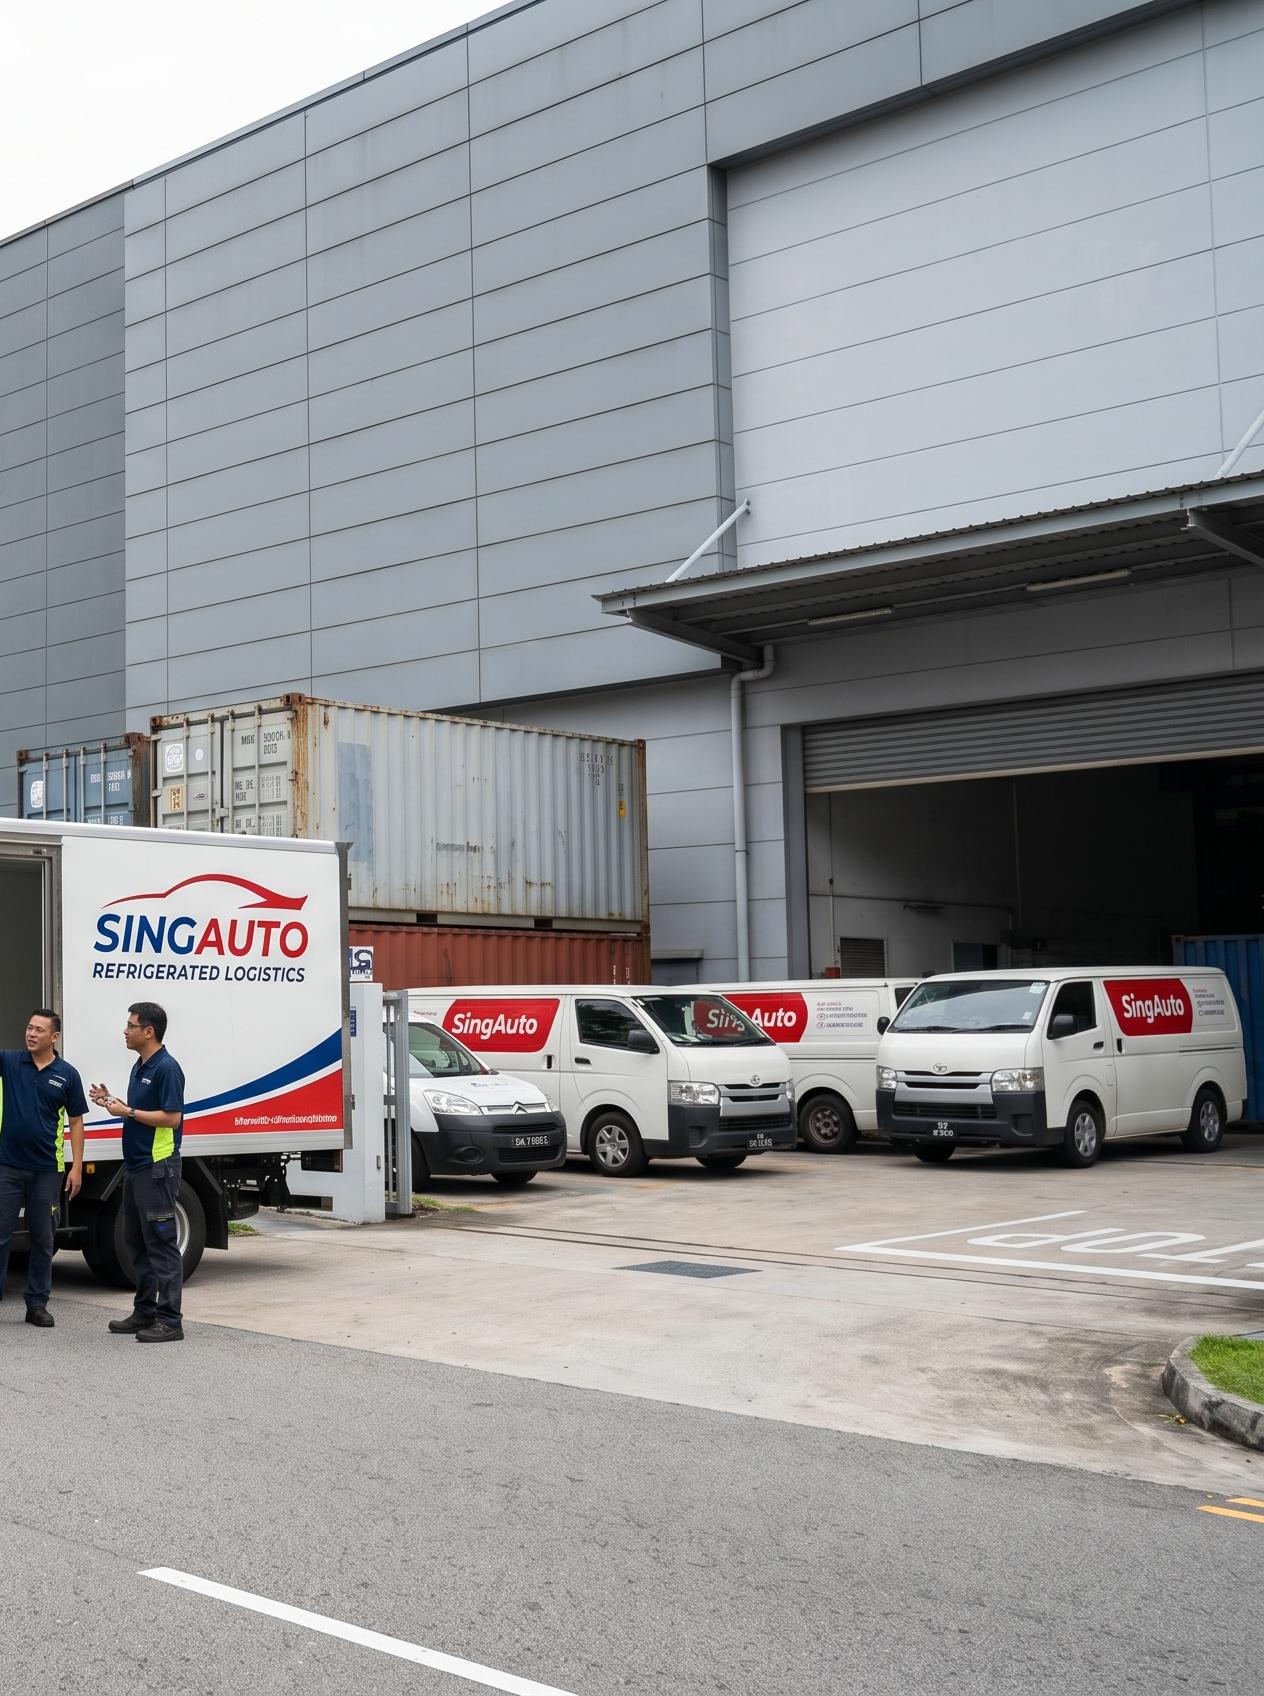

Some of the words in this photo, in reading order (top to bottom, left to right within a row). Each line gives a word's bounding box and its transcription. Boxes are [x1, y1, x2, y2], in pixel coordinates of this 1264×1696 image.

[93, 913, 309, 959] SINGAUTO
[92, 962, 220, 981] REFRIGERATED
[224, 966, 305, 983] LOGISTICS
[1121, 992, 1185, 1024] SingAuto
[451, 1011, 538, 1040] SingAuto
[966, 1226, 1264, 1268] TOP
